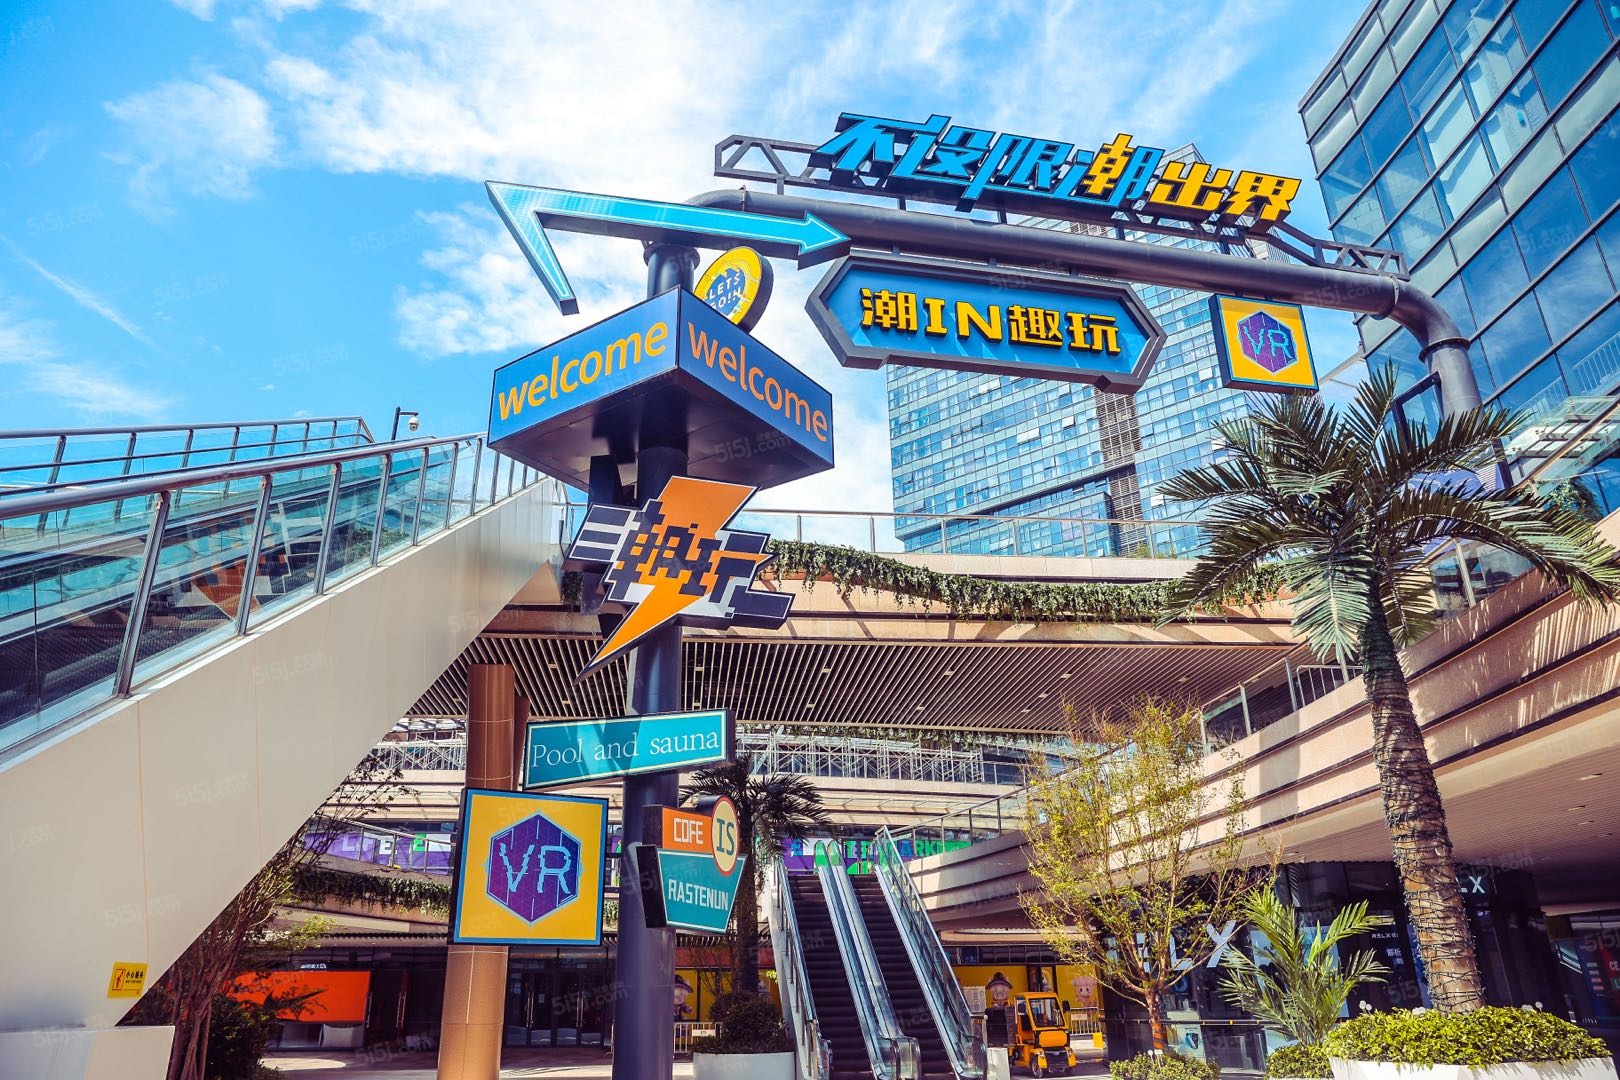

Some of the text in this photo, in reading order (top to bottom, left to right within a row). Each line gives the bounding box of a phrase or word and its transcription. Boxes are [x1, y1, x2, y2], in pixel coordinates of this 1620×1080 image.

[814, 112, 1301, 222] 不设限潮出界
[860, 287, 1121, 354] 潮IN趣玩
[1239, 322, 1297, 362] VR
[497, 320, 670, 422] welcome
[688, 320, 829, 445] welcome
[531, 731, 721, 769] Pool and sauna
[716, 817, 736, 857] IS
[499, 842, 572, 895] VR
